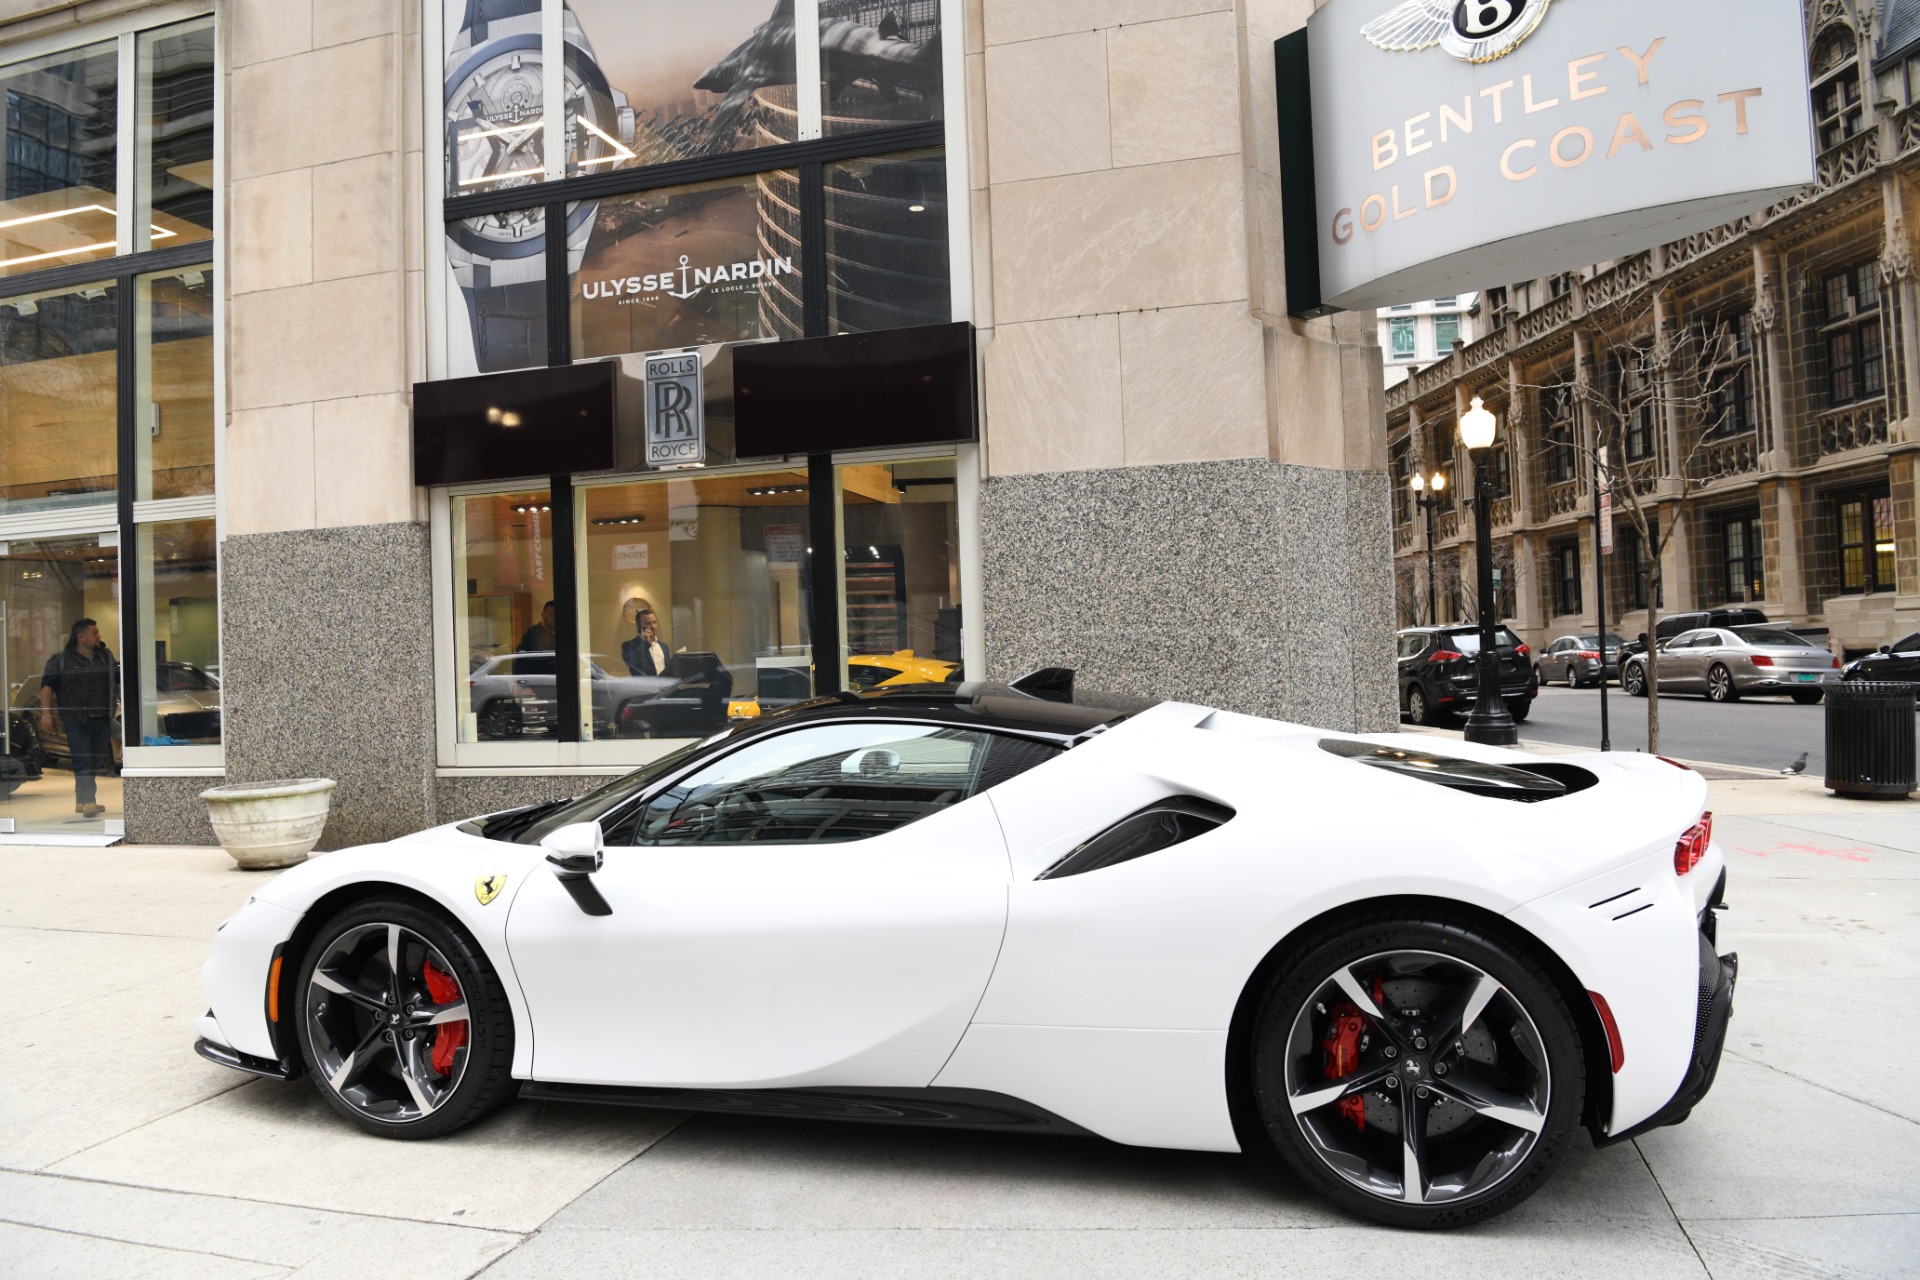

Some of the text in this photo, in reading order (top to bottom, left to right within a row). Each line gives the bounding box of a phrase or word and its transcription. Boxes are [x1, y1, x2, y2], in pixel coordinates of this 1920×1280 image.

[1464, 0, 1513, 34] B
[486, 107, 543, 122] ULYSSE NARDI
[1370, 36, 1666, 172] BENTLEY
[1331, 87, 1763, 246] GOLD COAST
[582, 256, 793, 300] ULYSSE NARDIN
[649, 359, 694, 376] ROLLS
[651, 442, 696, 459] ROYCE
